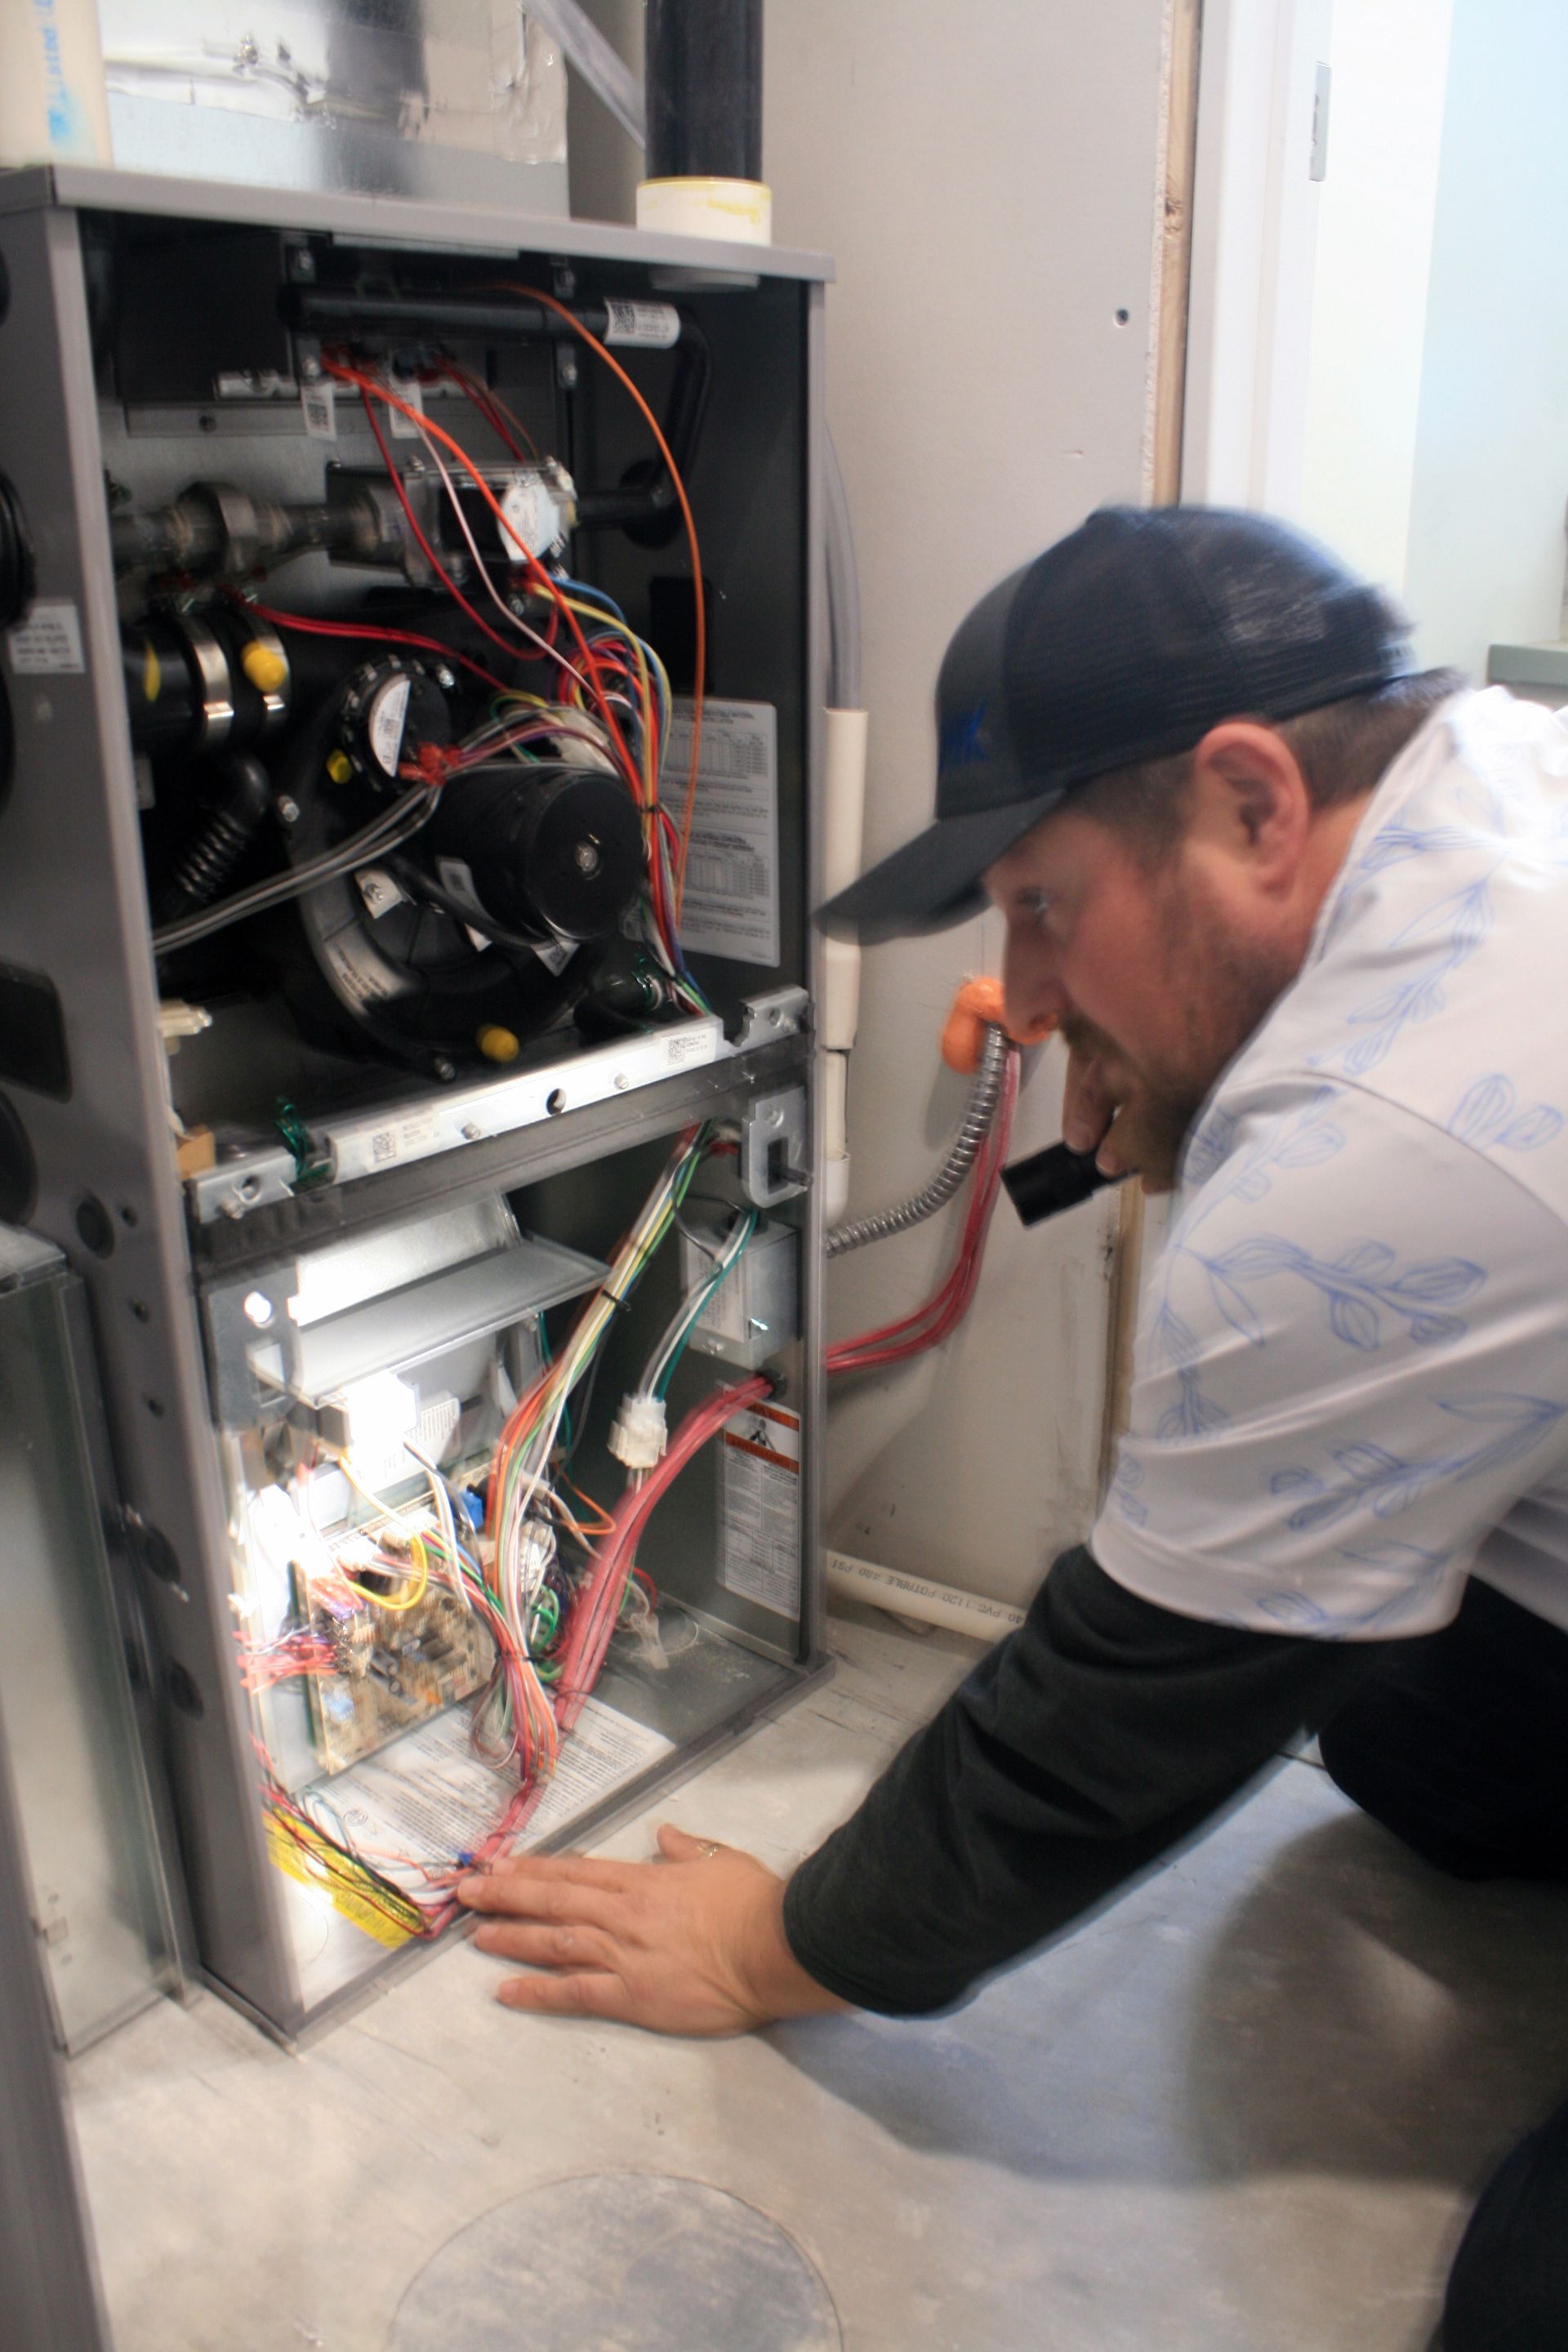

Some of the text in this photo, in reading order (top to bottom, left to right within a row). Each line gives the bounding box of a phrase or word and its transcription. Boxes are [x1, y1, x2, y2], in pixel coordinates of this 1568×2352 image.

[831, 1558, 853, 1573] PSI
[886, 1575, 937, 1598] POTABLE
[942, 1593, 970, 1608] 1120
[978, 1605, 1001, 1618] PVC
